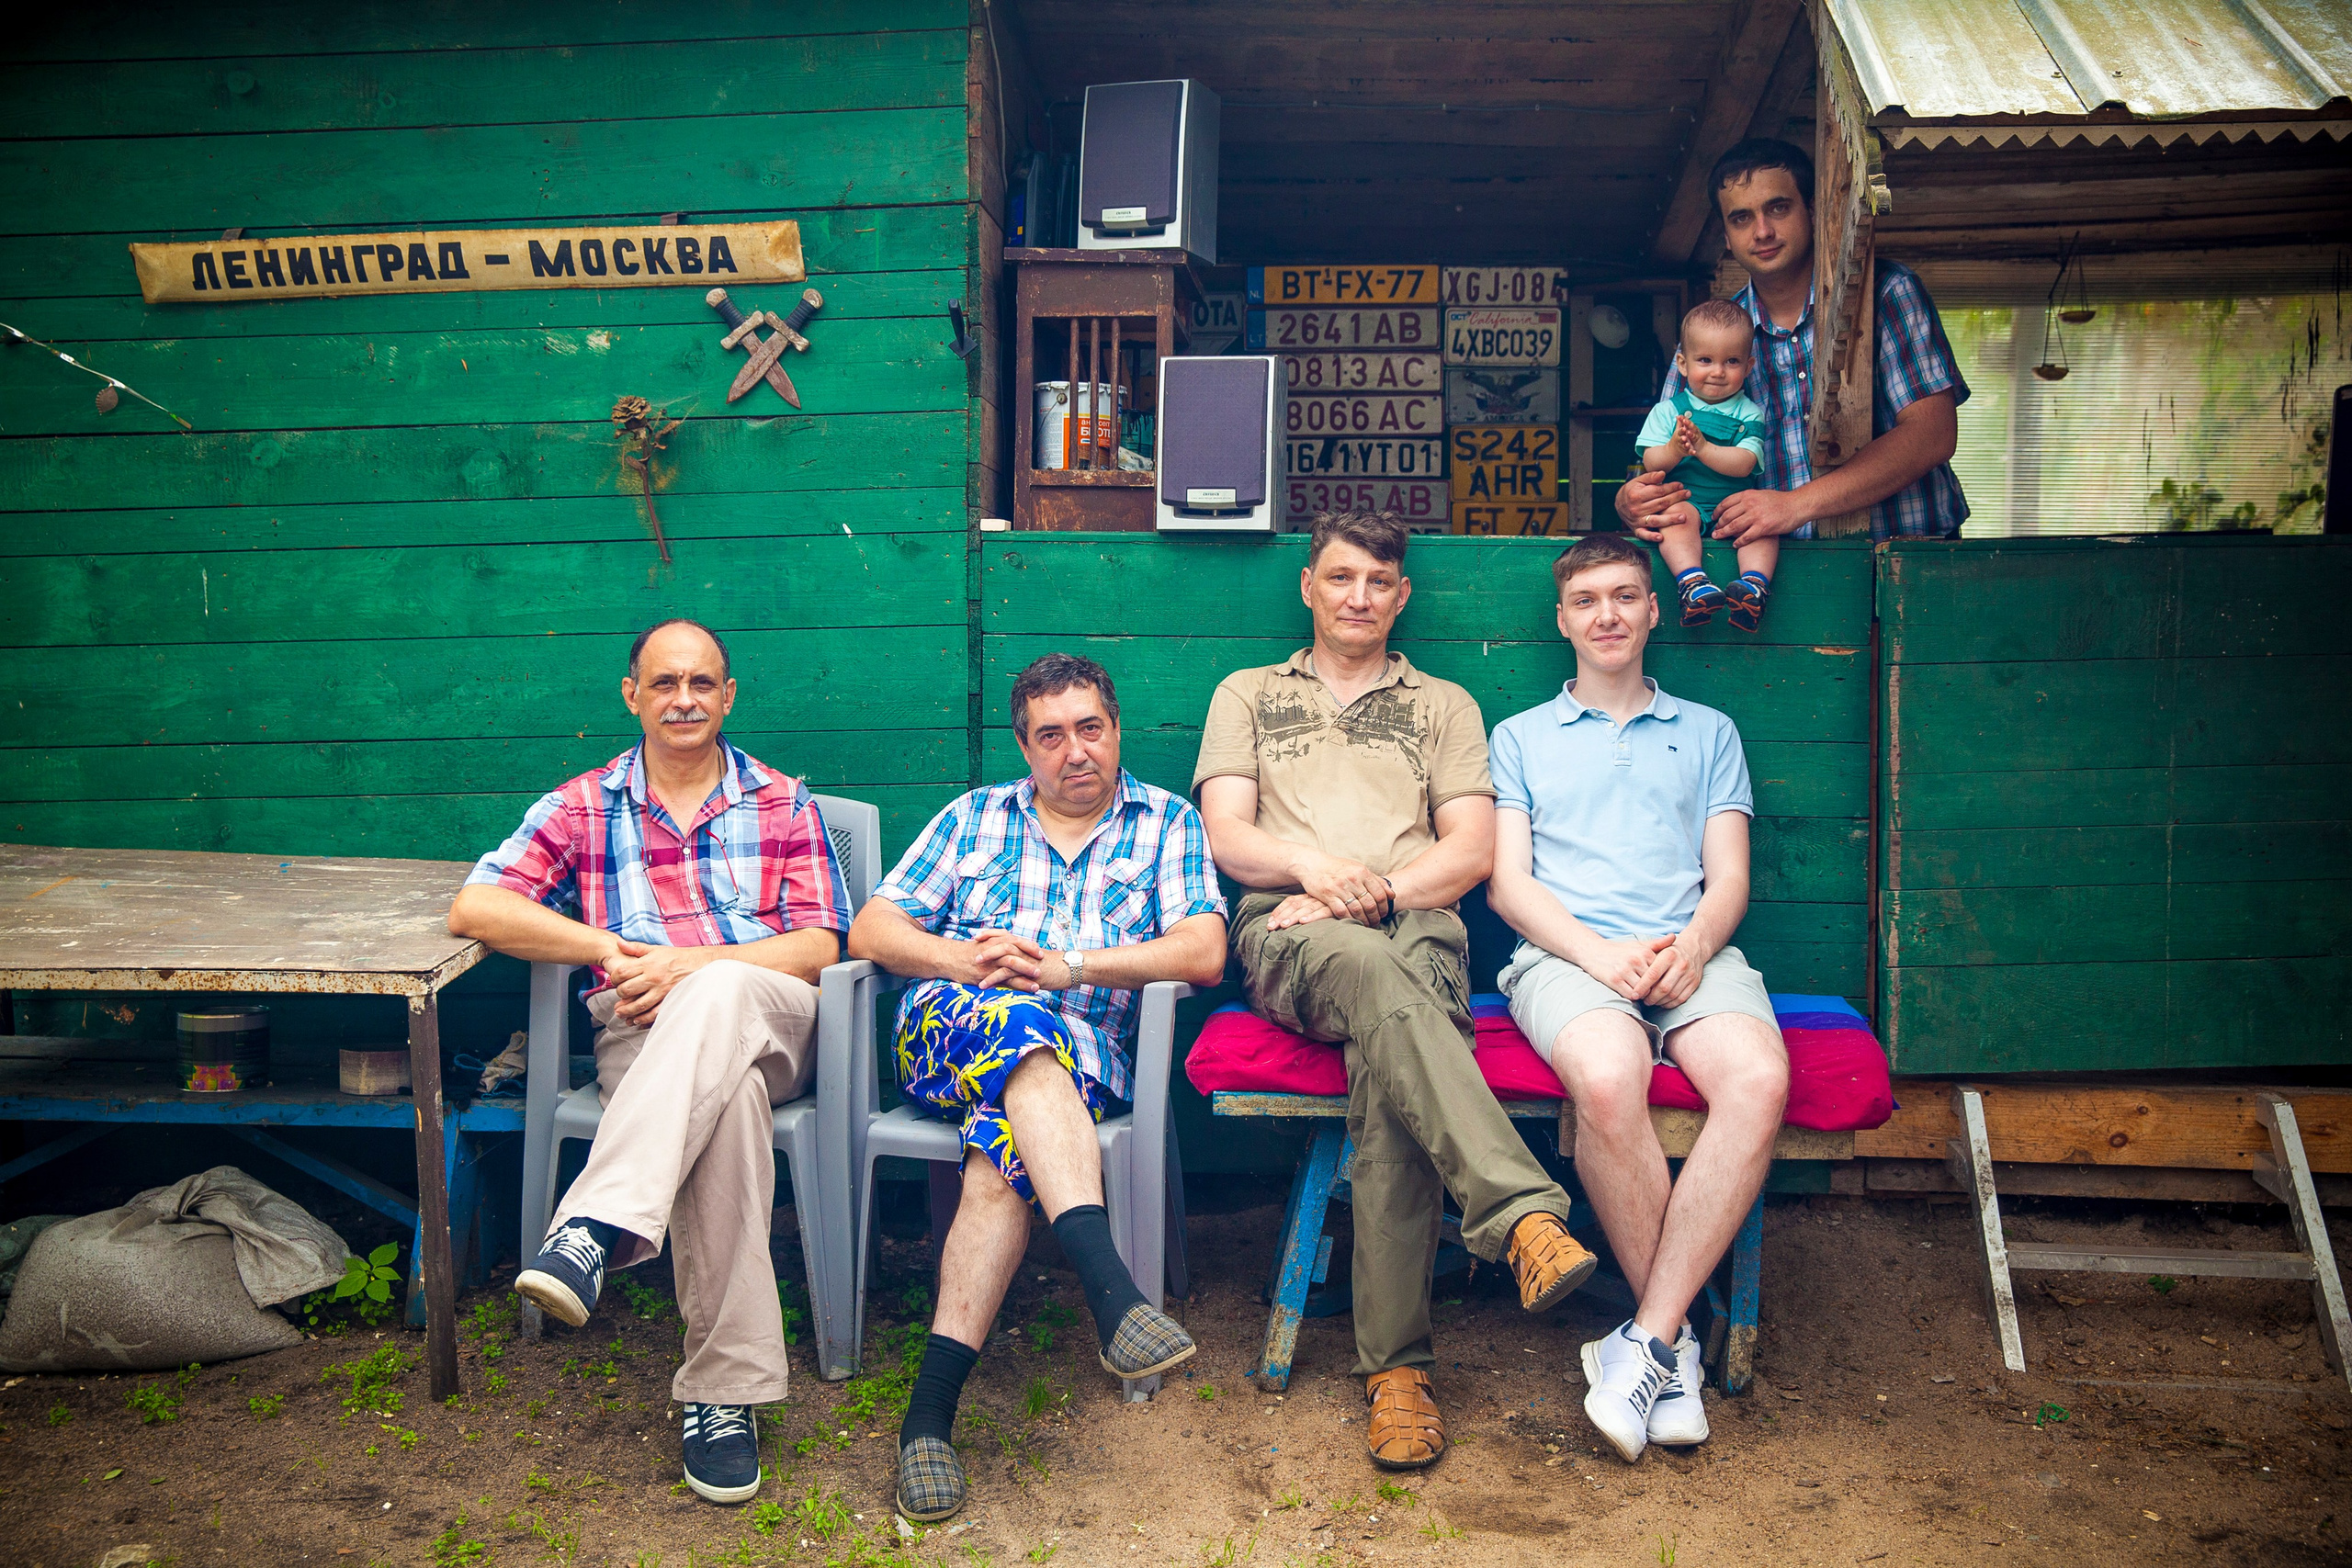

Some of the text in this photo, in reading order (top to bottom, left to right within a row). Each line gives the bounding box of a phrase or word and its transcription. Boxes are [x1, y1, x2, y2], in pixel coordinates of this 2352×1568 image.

[192, 241, 470, 291] ЛЕНИНГРАД
[527, 235, 739, 276] МОСКВА
[1250, 290, 1261, 299] NL
[1283, 269, 1425, 299] BT-FX-77
[1194, 300, 1238, 327] OTA
[1468, 311, 1539, 329] California
[1250, 334, 1262, 344] LT
[1452, 328, 1553, 358] 4XBC039
[1454, 429, 1555, 461] S242
[1469, 464, 1544, 499] AHR
